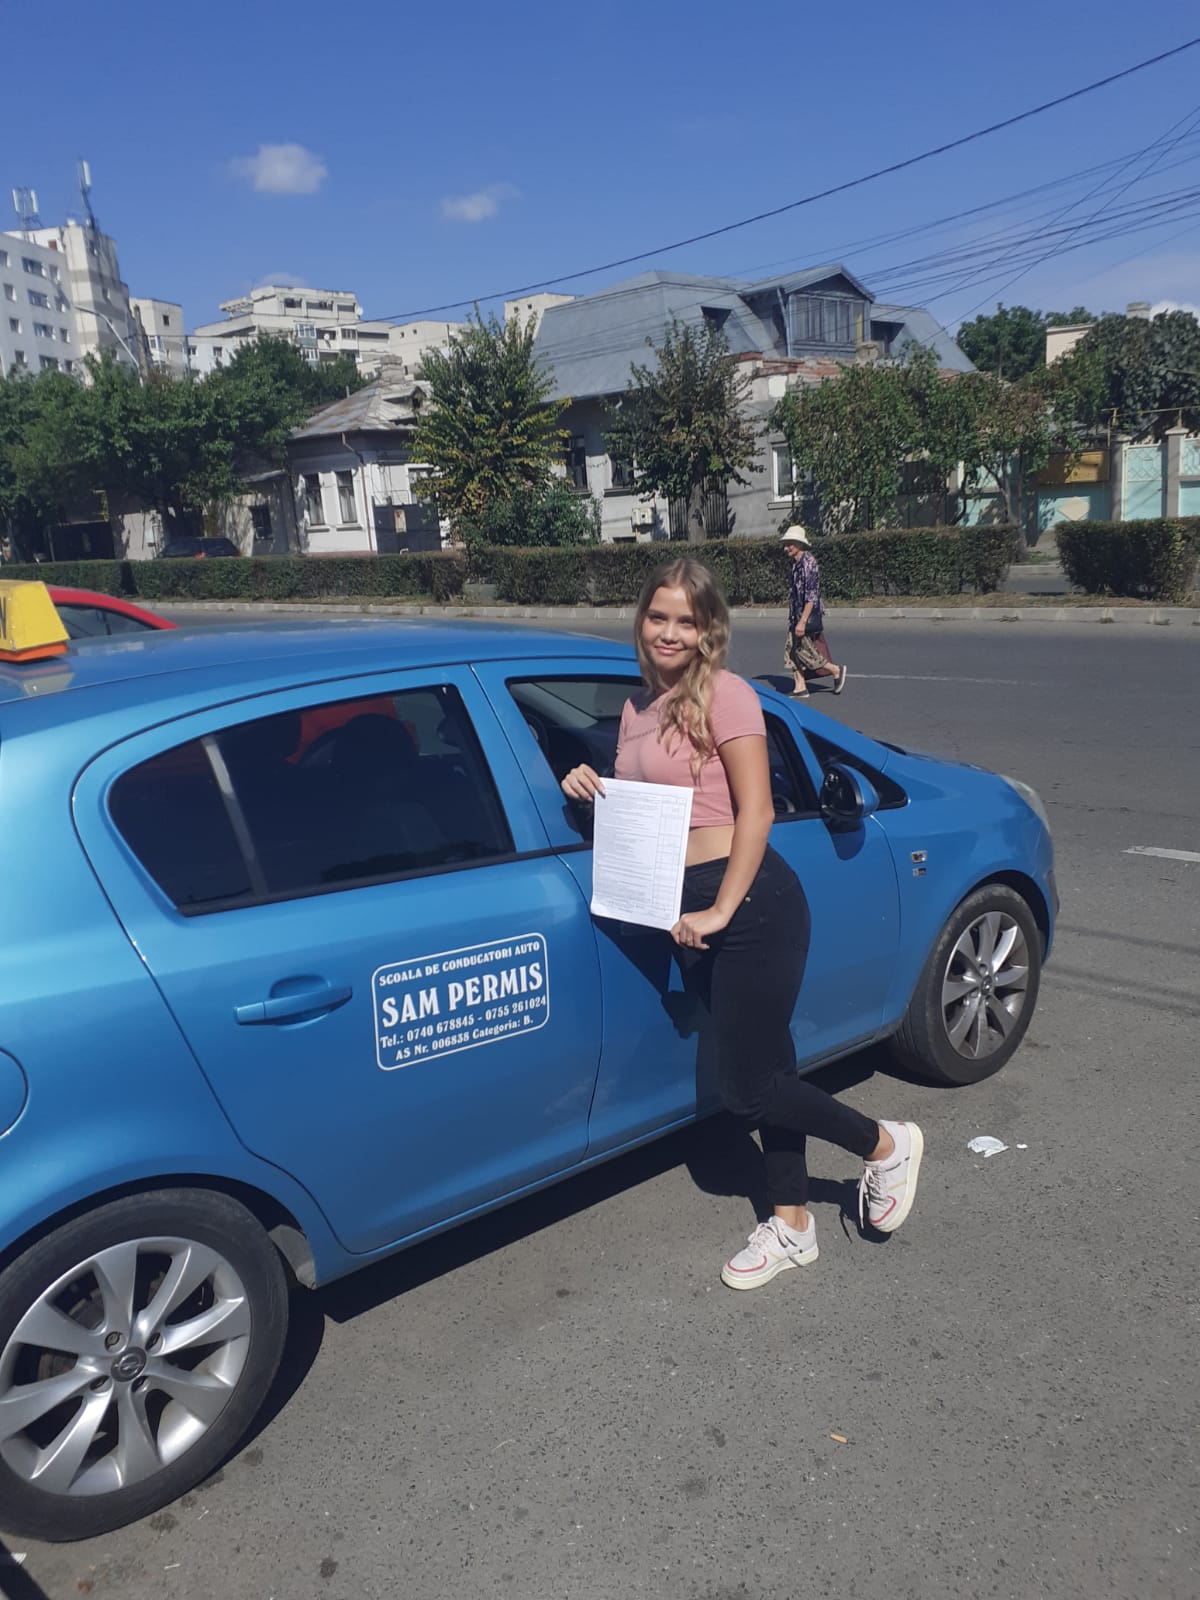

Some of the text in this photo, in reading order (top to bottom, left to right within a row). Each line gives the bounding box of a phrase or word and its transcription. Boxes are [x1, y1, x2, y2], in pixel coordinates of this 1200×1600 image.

[379, 941, 540, 987] SCOALA DE CONDUCATORI AUTO
[382, 962, 543, 1028] SAM PERMIS
[395, 1047, 411, 1061] AS
[414, 1044, 429, 1055] Nr.
[472, 1020, 521, 1040] Categoria:
[523, 1015, 534, 1026] B.
[406, 1024, 434, 1042] 0740
[436, 1014, 475, 1034] 678845
[485, 1004, 510, 1021] 0755
[512, 995, 546, 1014] 261024
